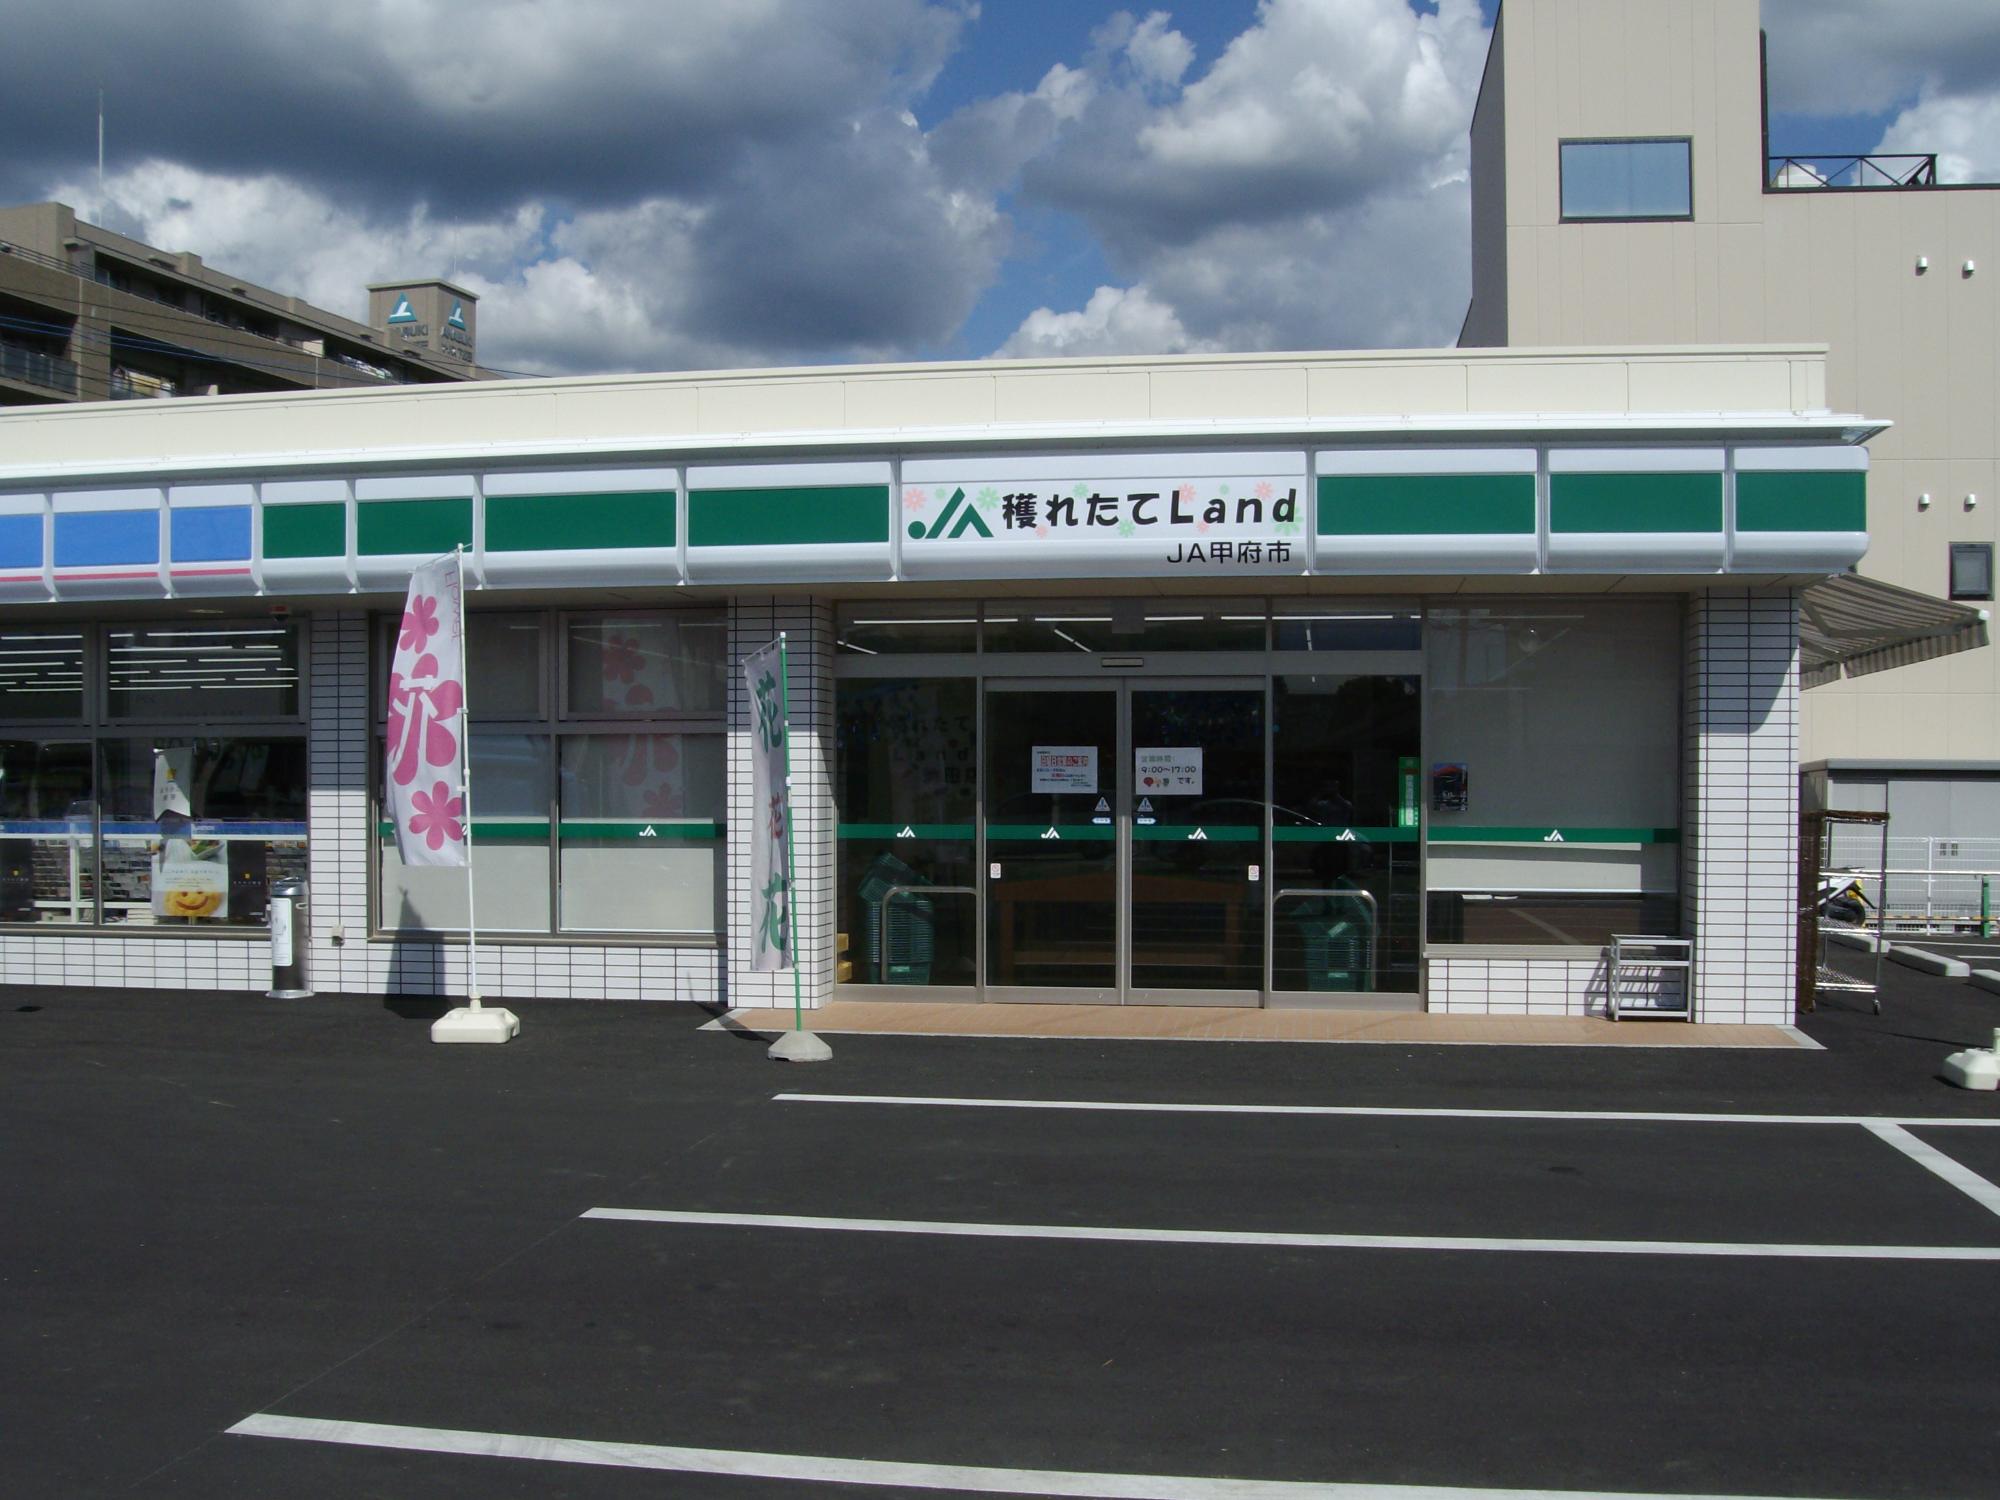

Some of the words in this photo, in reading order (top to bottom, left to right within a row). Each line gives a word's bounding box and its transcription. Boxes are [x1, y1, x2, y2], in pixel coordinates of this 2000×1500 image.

[1002, 488, 1297, 529] 穫れたてLand
[1166, 540, 1292, 564] JA甲府市
